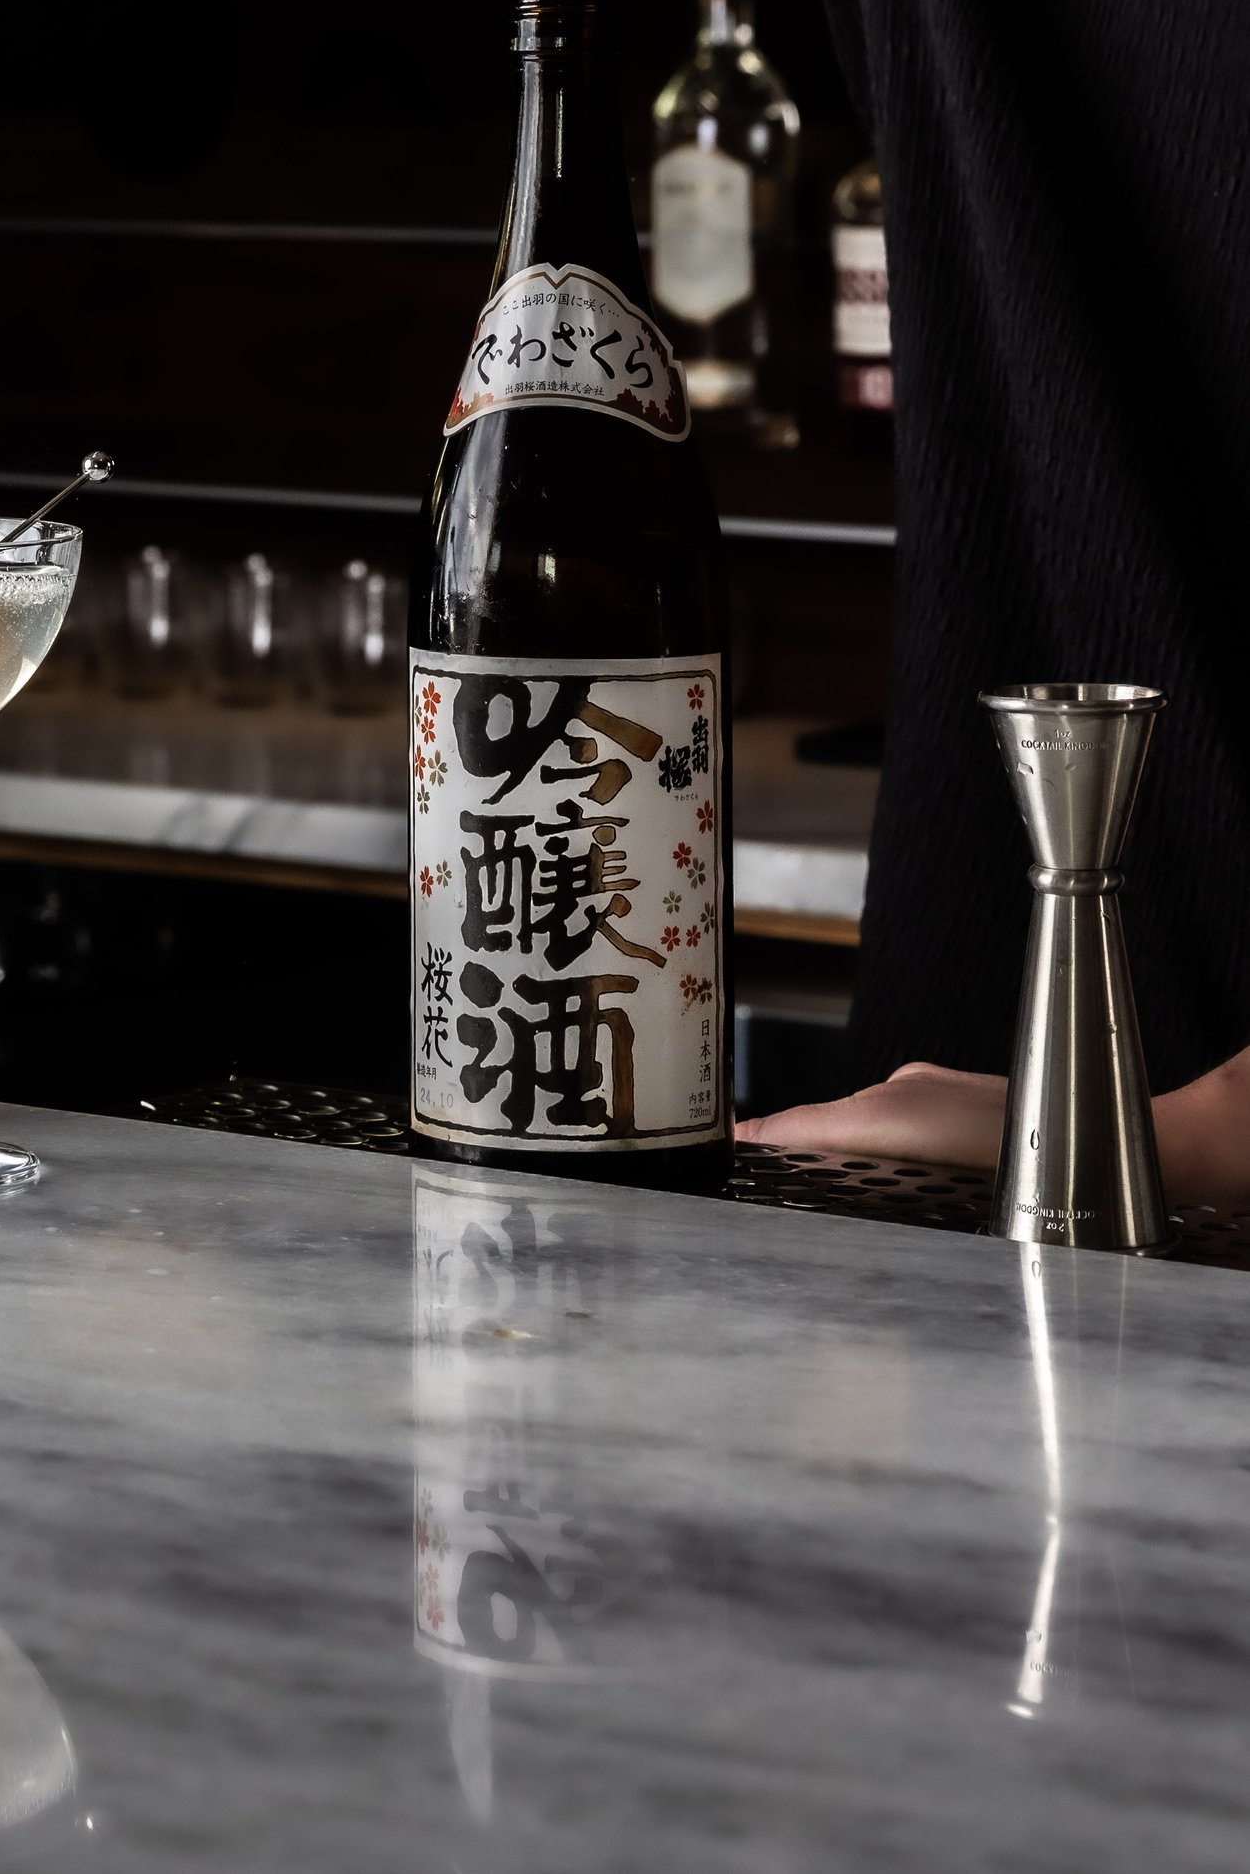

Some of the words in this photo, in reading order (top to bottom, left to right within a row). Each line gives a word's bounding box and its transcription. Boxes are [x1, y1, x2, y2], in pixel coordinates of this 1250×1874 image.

[472, 321, 654, 389] でわざくら
[504, 379, 606, 397] 出羽桜酒造株式会社
[1021, 739, 1063, 751] COCKTAIL
[421, 941, 454, 1068] 桜花
[699, 1018, 712, 1084] 日本酒
[689, 1089, 712, 1106] 内容量
[1057, 1209, 1100, 1220] OCKTAIL
